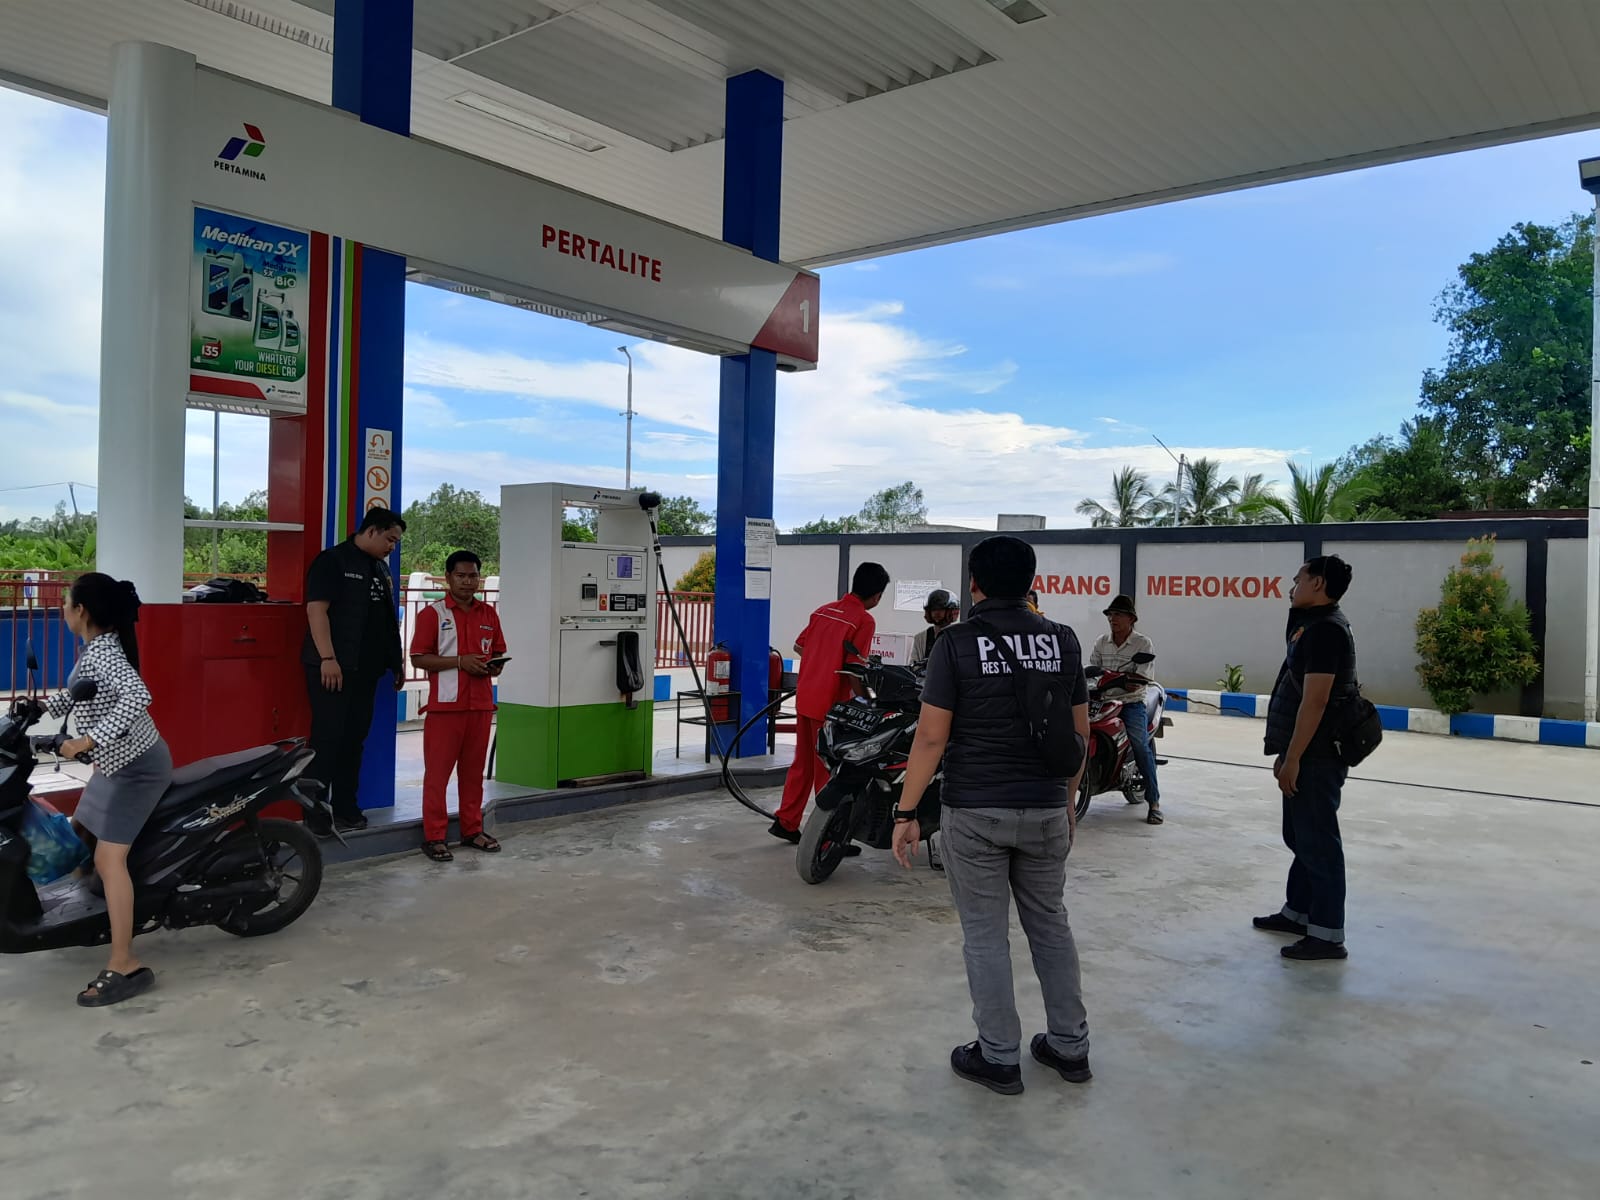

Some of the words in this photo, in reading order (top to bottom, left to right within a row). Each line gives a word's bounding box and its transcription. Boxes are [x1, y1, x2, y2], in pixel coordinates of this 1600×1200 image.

[214, 160, 266, 181] PERTAMINA
[201, 225, 274, 253] Meditran
[274, 241, 303, 258] SX
[542, 224, 662, 282] PERTALITE
[799, 299, 810, 334] 1
[202, 344, 219, 357] 135
[257, 351, 297, 366] WHATEVER
[234, 359, 254, 371] YOUR
[256, 362, 281, 376] DIESEL
[281, 365, 297, 378] CAR
[1032, 575, 1110, 596] ARANG
[1147, 575, 1282, 599] MEROKOK
[981, 661, 1000, 675] RES
